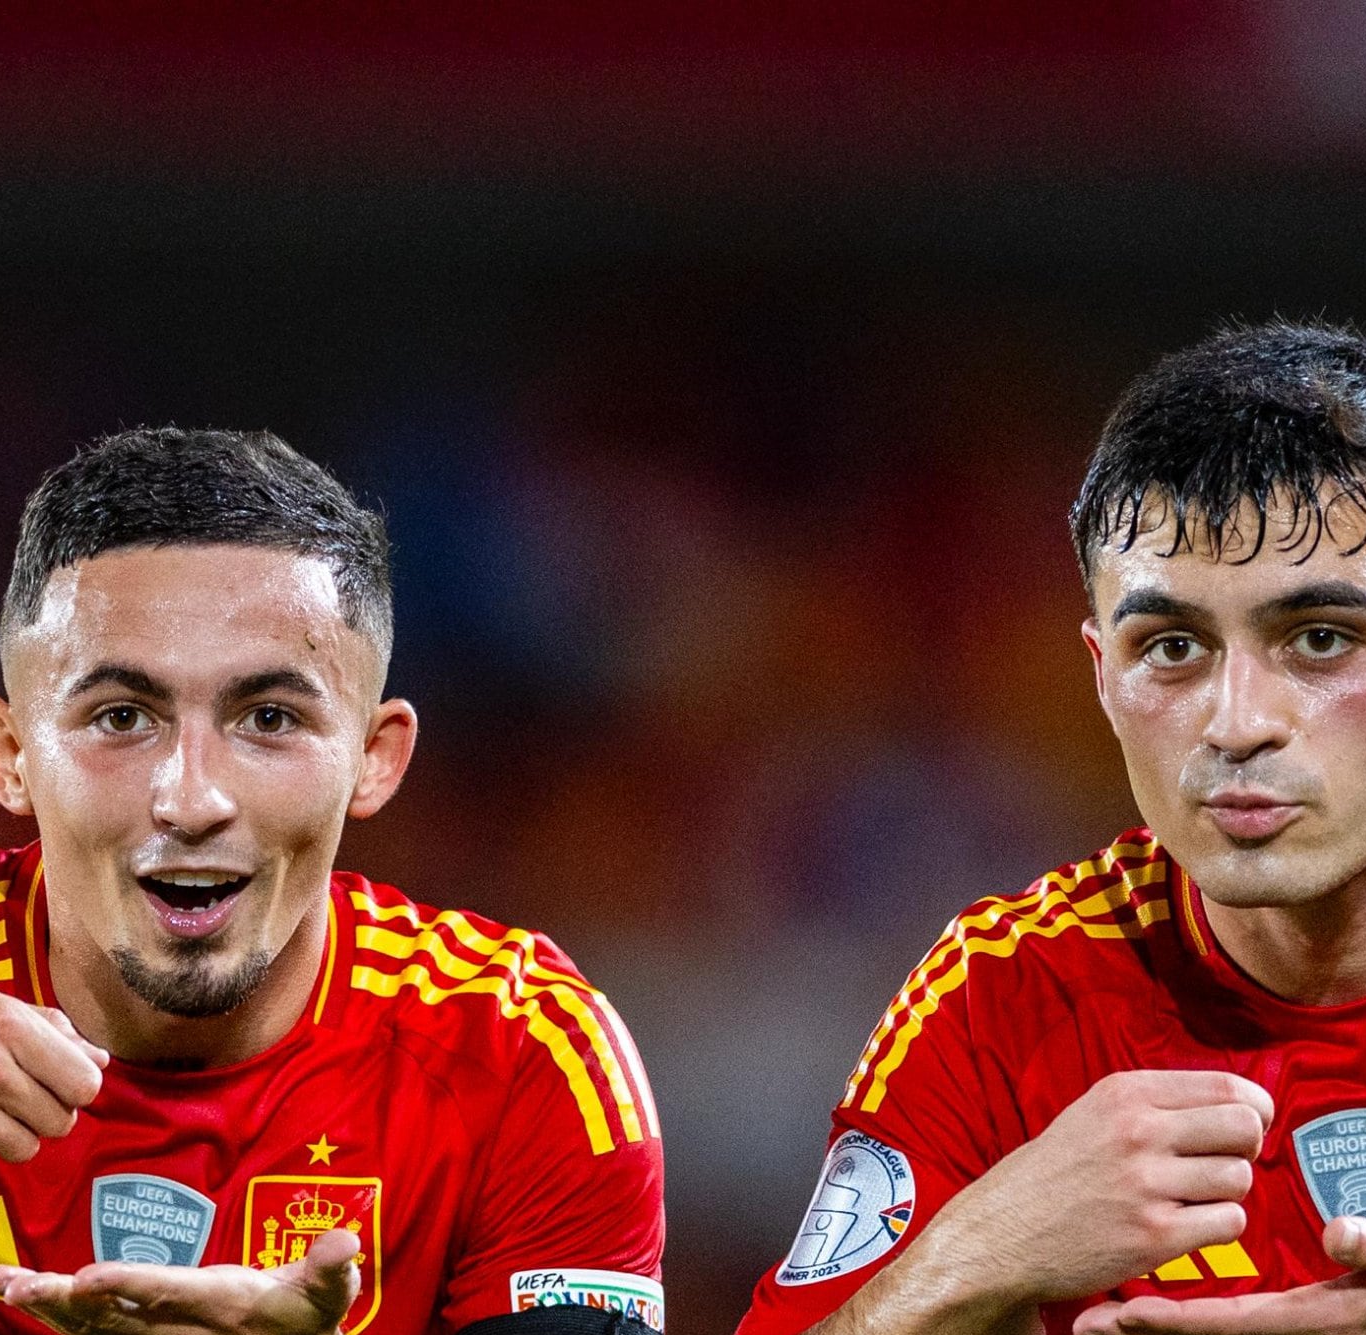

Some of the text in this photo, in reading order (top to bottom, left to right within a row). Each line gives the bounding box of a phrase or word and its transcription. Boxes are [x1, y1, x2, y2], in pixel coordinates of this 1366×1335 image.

[871, 1140, 906, 1180] LEAGUE
[136, 1185, 174, 1204] UEFA
[103, 1195, 202, 1228] EUROPEAN
[101, 1212, 197, 1244] CHAMPIONS
[516, 1273, 566, 1290] UEFA
[811, 1263, 842, 1279] 2023
